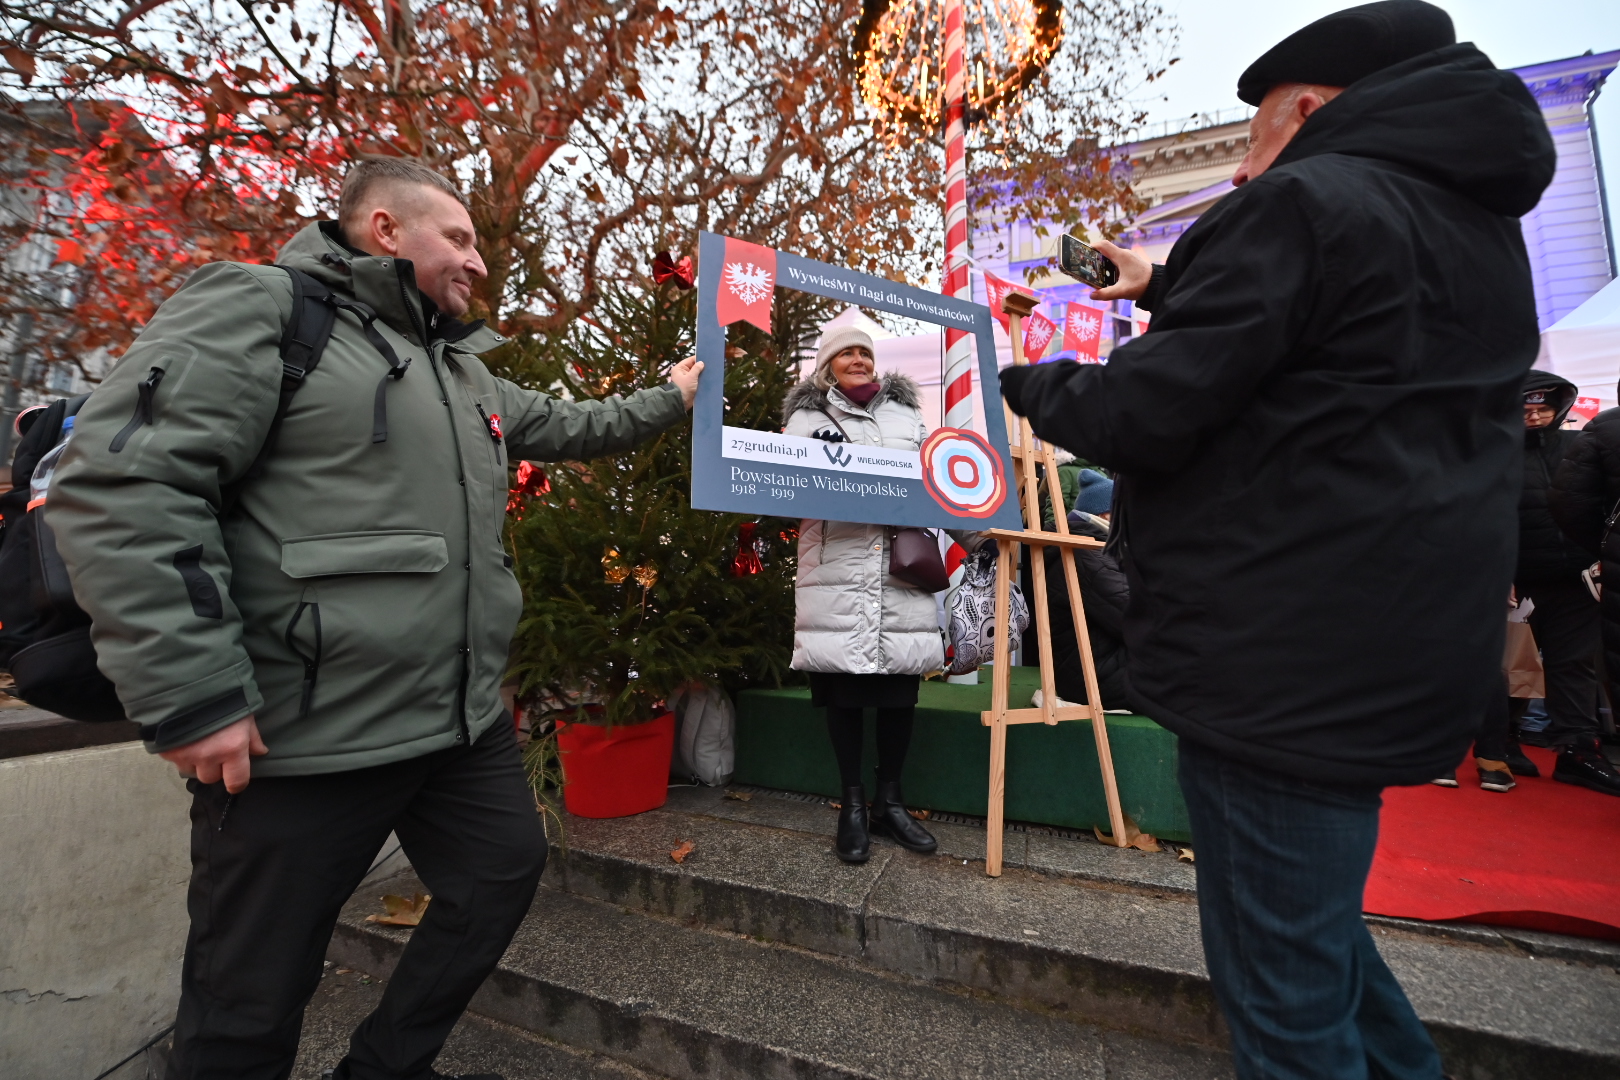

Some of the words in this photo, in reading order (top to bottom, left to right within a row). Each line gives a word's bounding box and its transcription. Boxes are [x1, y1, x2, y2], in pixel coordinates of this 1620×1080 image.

[788, 266, 857, 295] WywieśMY
[859, 285, 885, 302] flagi
[886, 292, 904, 307] dla
[906, 297, 975, 324] Powstańców!
[730, 438, 808, 458] 27grudnia.pl
[857, 456, 913, 469] WIELKOPOLSKA
[730, 466, 809, 488] Powstanie
[812, 475, 908, 498] Wielkopolskie
[730, 483, 756, 496] 1918
[770, 487, 795, 501] 1919
